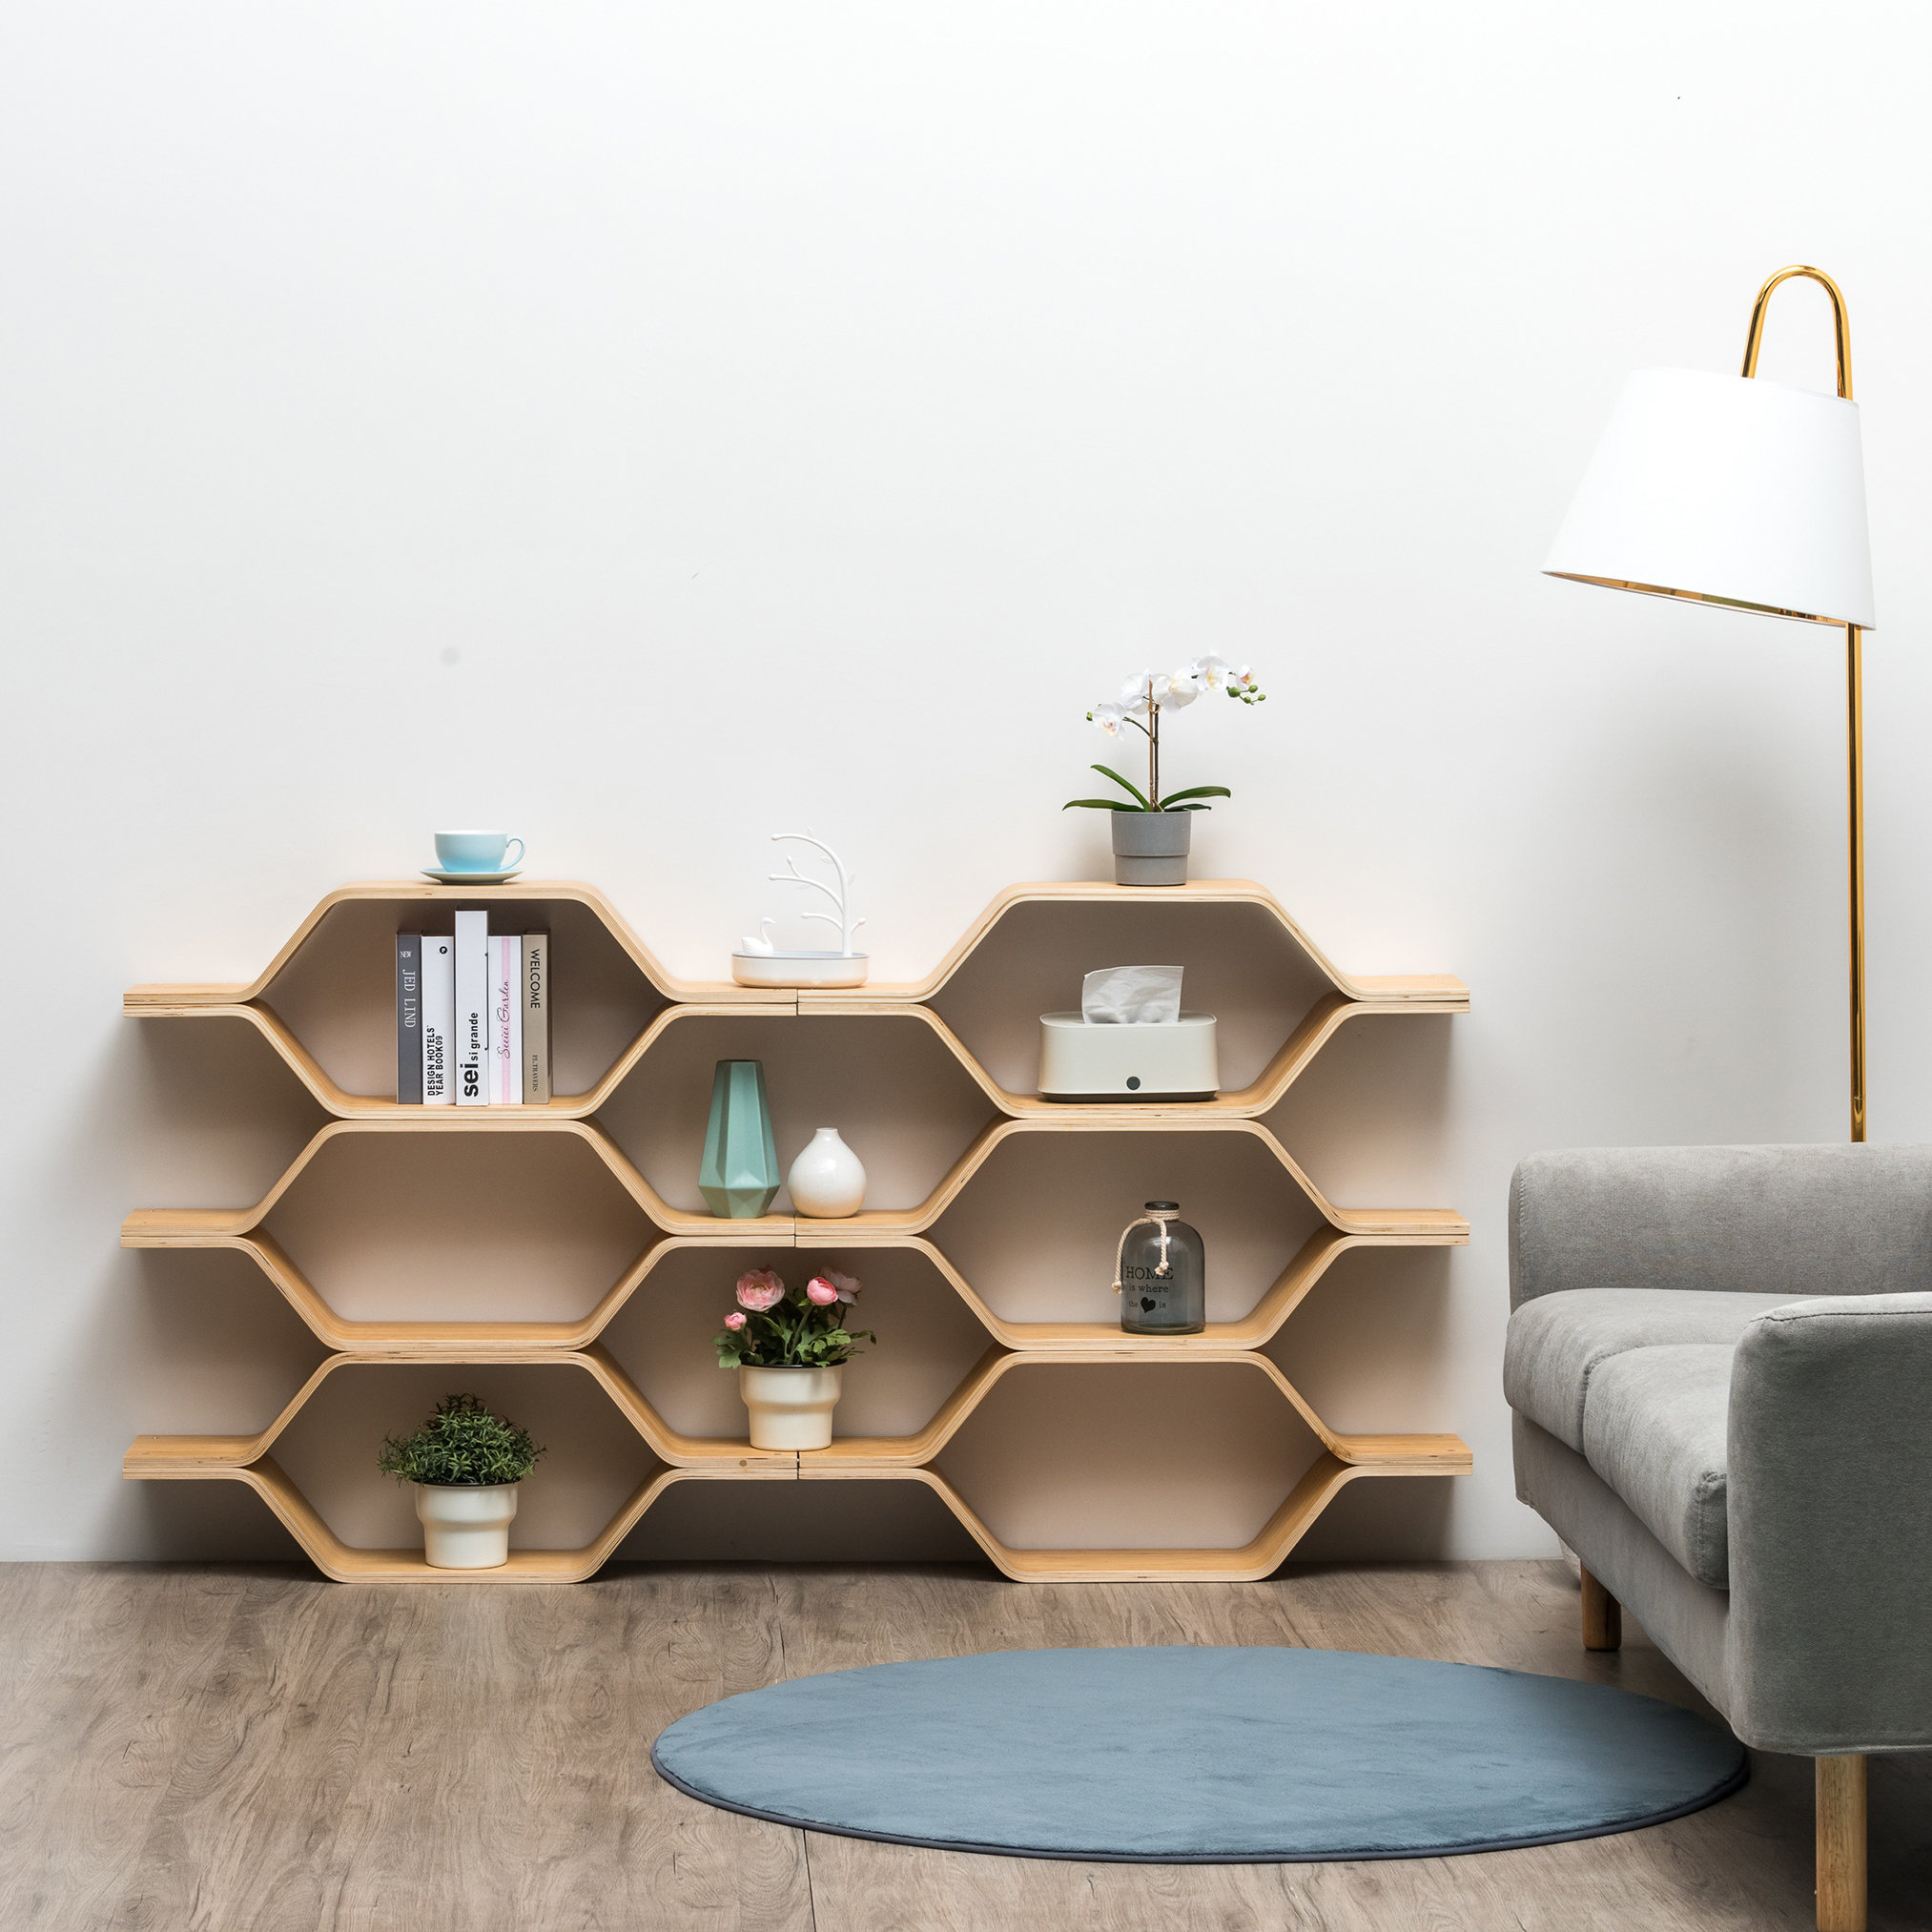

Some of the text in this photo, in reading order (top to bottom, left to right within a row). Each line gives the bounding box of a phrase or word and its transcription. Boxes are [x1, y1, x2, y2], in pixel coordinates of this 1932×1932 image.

[402, 969, 416, 992] JED
[529, 948, 541, 1009] WELCOME
[404, 998, 417, 1029] LIND
[468, 1012, 481, 1050] grande
[427, 1064, 436, 1097] DESIGN
[435, 1036, 443, 1097] YEAR BOOK09
[460, 1063, 479, 1098] sei
[1126, 1266, 1174, 1280] HOME
[1138, 1284, 1169, 1293] where
